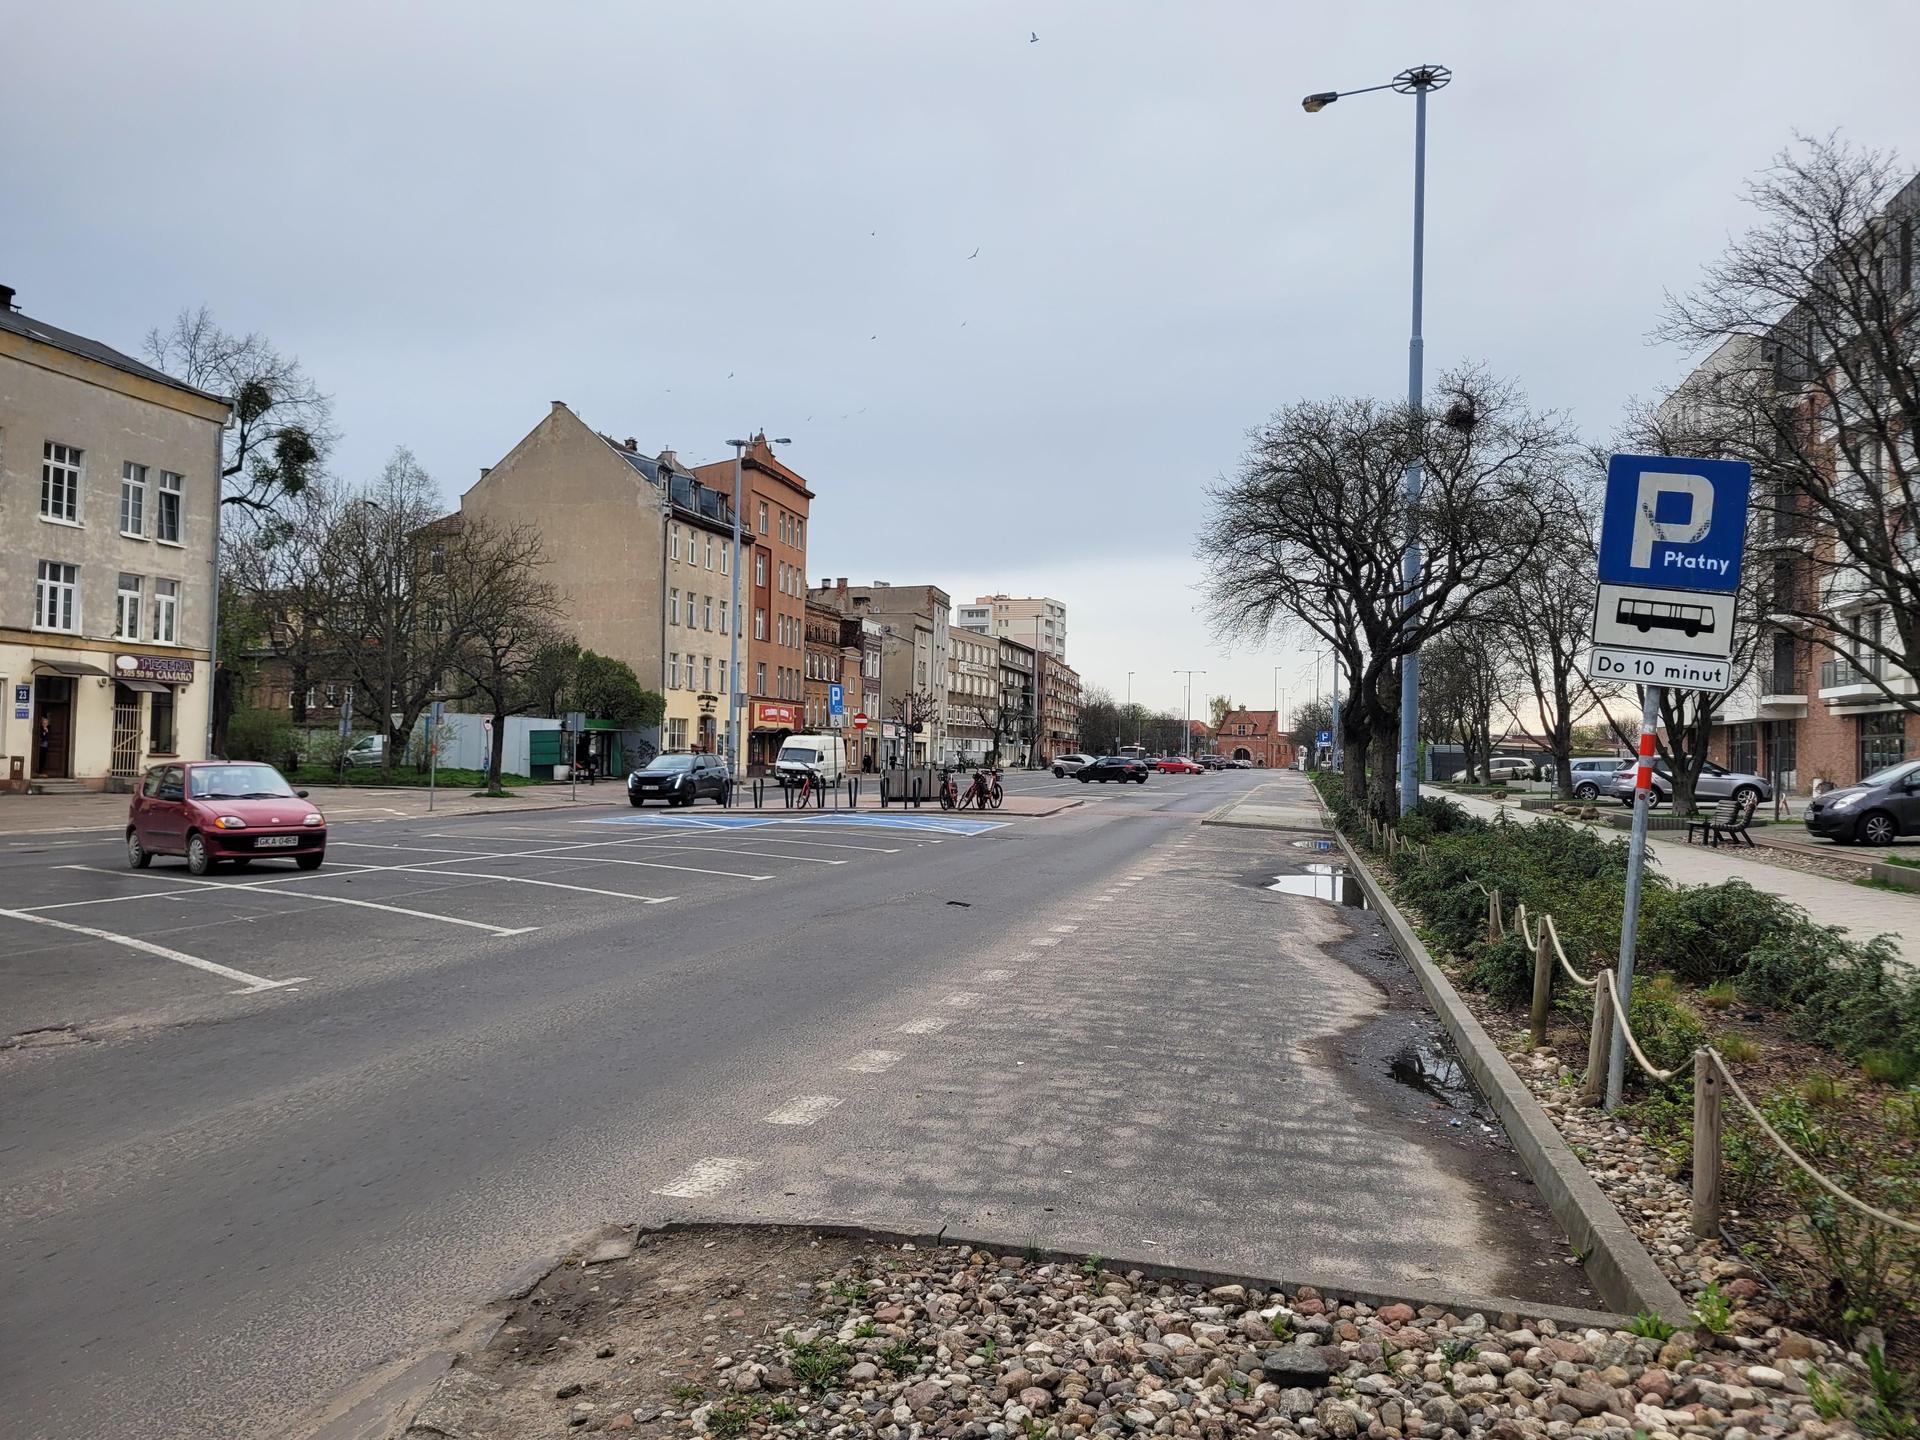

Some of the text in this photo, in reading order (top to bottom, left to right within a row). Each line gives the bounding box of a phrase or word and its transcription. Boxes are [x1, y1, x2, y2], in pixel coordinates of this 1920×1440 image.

[1630, 471, 1715, 569] P
[1663, 550, 1730, 576] Płatny
[140, 658, 193, 672] PIZZERIA
[1597, 656, 1722, 683] Do 10 minut
[156, 670, 192, 682] CAMARO
[18, 690, 27, 700] 23
[832, 687, 840, 705] P
